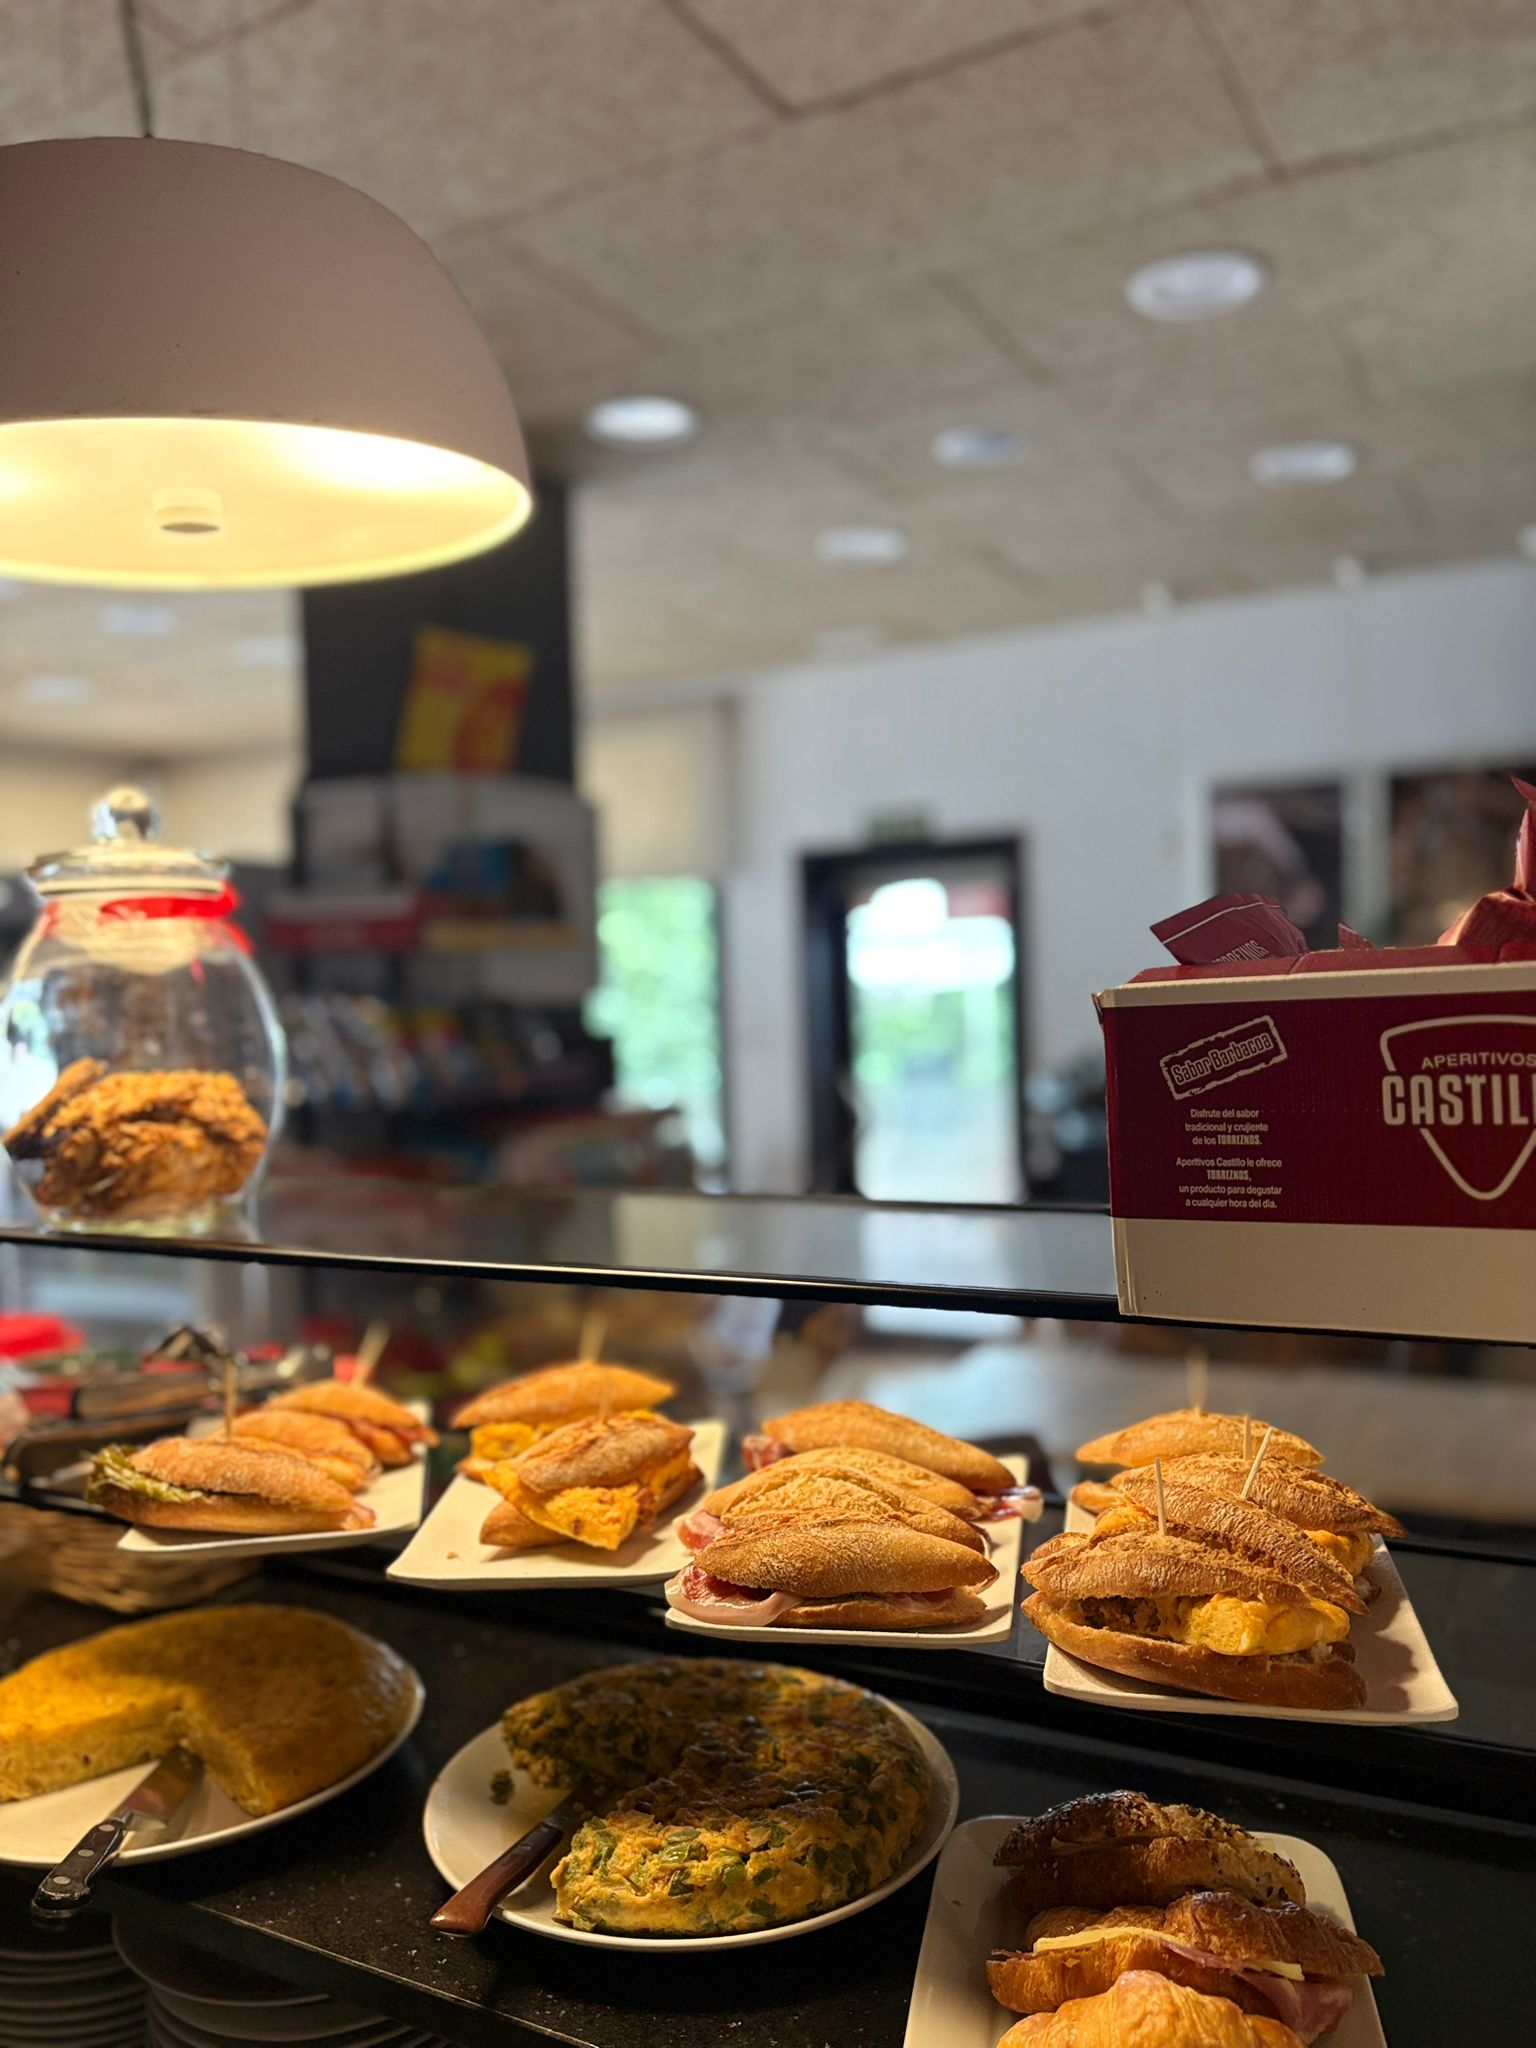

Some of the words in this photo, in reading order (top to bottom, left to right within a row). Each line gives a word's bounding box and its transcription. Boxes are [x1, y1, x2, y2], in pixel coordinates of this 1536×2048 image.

[1171, 1058, 1211, 1085] Sabor
[1208, 1033, 1274, 1070] Barbacoa
[1422, 1052, 1536, 1069] APERITIVOS
[1190, 1109, 1221, 1118] Disfrute
[1222, 1109, 1235, 1118] del
[1236, 1109, 1259, 1118] sabor
[1185, 1123, 1226, 1132] tradicional
[1227, 1125, 1233, 1133] y
[1233, 1123, 1269, 1133] crujiente
[1192, 1136, 1203, 1145] de
[1204, 1136, 1217, 1145] los
[1217, 1134, 1263, 1145] TORREZNOS.
[1176, 1157, 1215, 1167] Aperitivos
[1216, 1158, 1246, 1167] Castillo
[1247, 1158, 1255, 1167] le
[1255, 1158, 1282, 1167] ofrece
[1207, 1170, 1252, 1182] TORREZNOS,
[1179, 1185, 1189, 1193] un
[1190, 1184, 1226, 1195] producto
[1227, 1186, 1246, 1196] para
[1246, 1185, 1282, 1196] degustar
[1185, 1199, 1191, 1207] a
[1191, 1198, 1228, 1208] cualquier
[1228, 1199, 1248, 1208] hora
[1248, 1199, 1262, 1208] del
